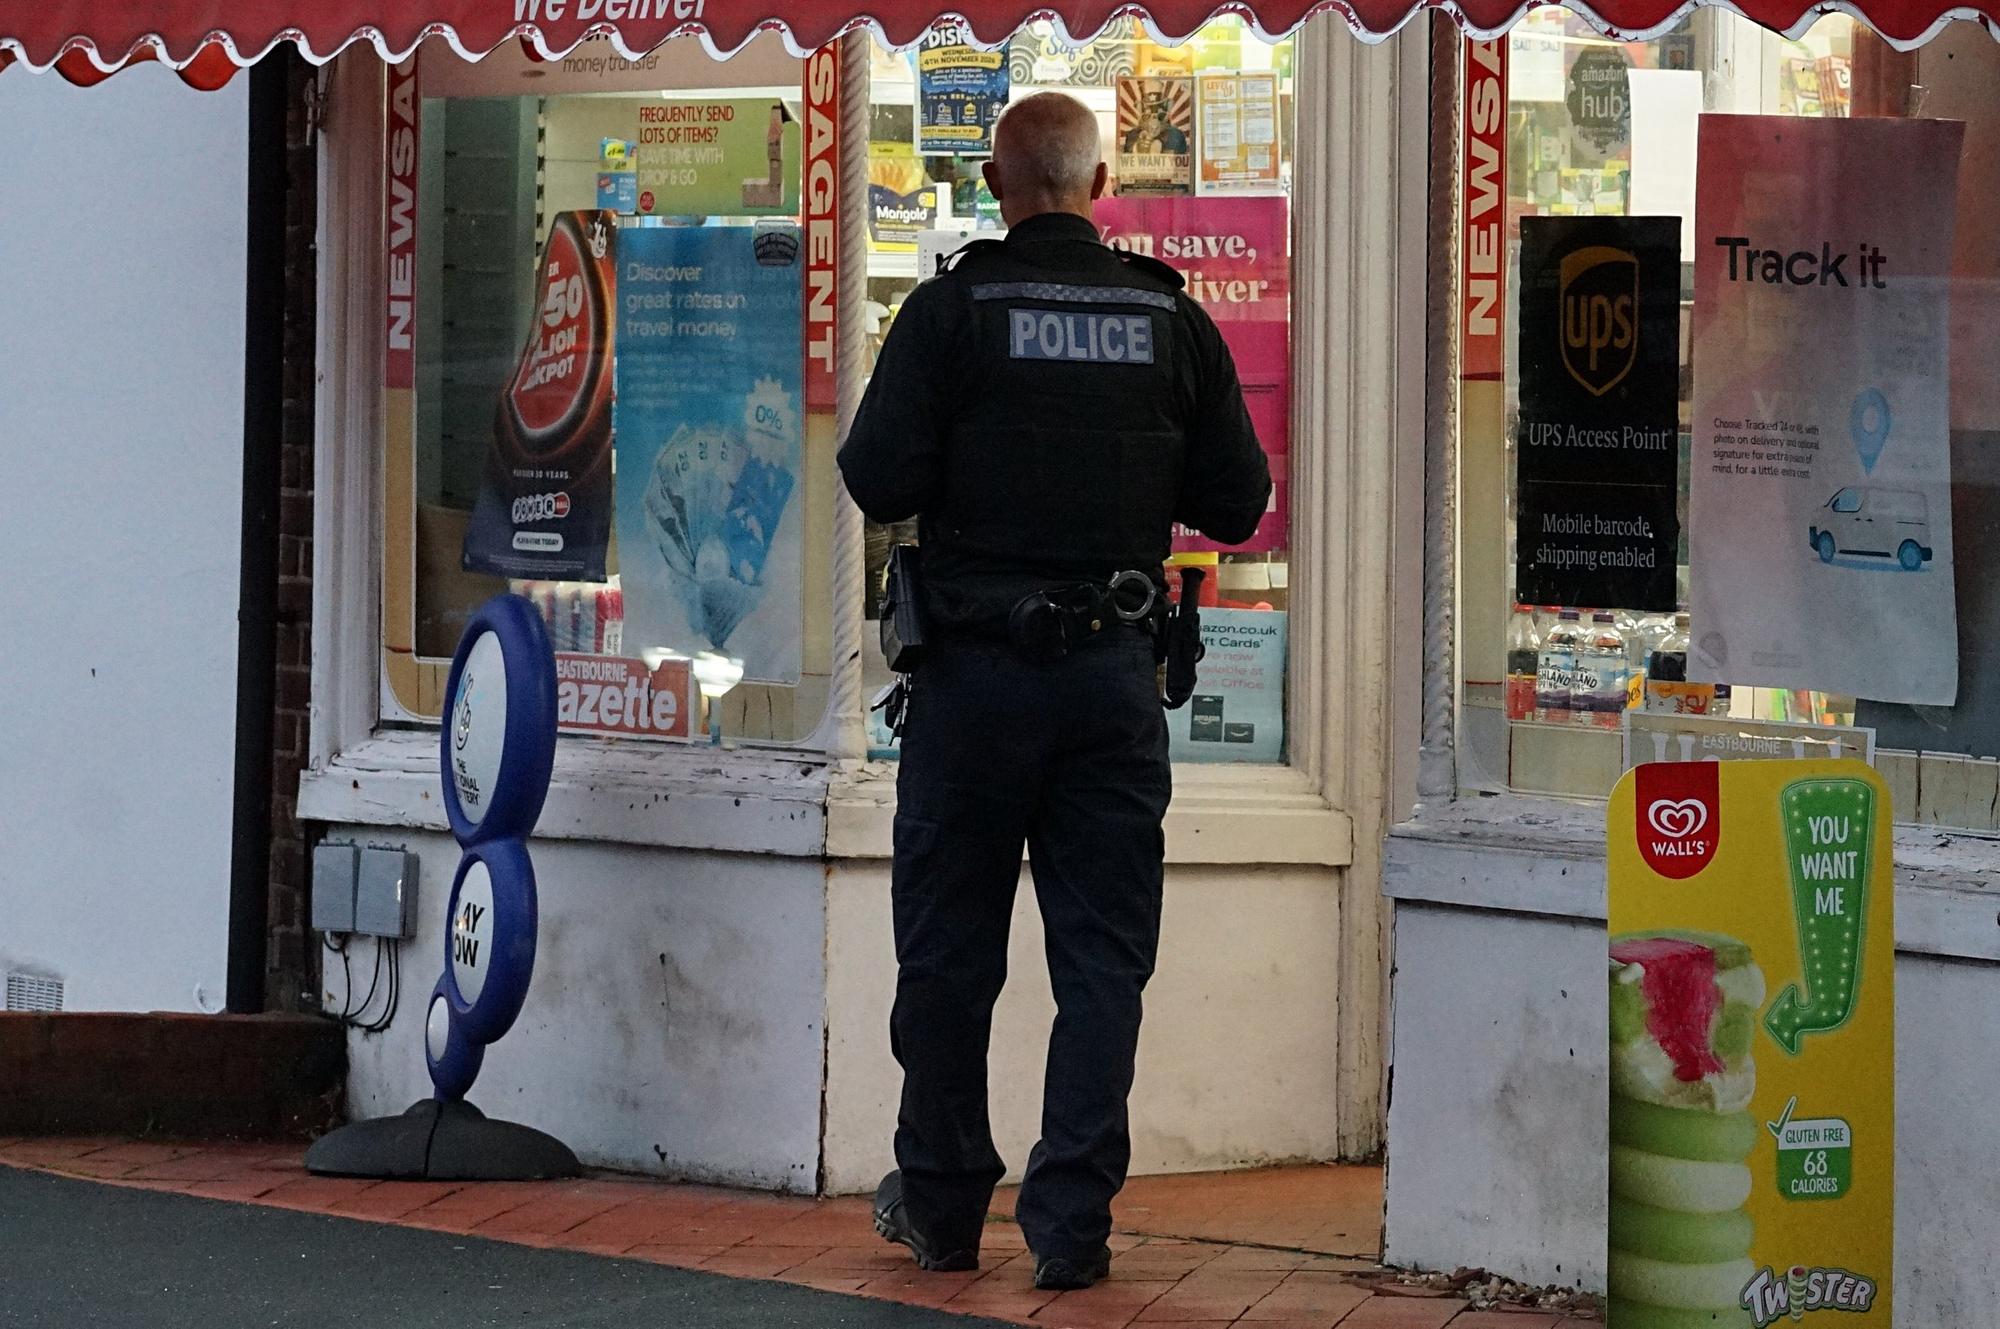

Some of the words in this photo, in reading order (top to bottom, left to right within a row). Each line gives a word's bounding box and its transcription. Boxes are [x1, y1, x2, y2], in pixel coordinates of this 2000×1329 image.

[514, 0, 566, 21] We
[577, 0, 706, 20] Deliver
[562, 58, 606, 77] money
[609, 54, 660, 73] transfer
[941, 55, 979, 64] NOVEMBER
[1581, 66, 1625, 82] amazon
[640, 106, 703, 123] FREQUENTLY
[707, 105, 734, 122] SEND
[1581, 87, 1623, 121] hub
[640, 128, 665, 144] LOTS
[667, 128, 681, 143] OF
[683, 127, 719, 143] ITEMS?
[640, 148, 666, 165] SAVE
[669, 148, 694, 164] TIME
[696, 148, 724, 164] WITH
[1120, 156, 1135, 167] WE
[1138, 156, 1166, 167] WANT
[640, 169, 666, 186] DROP
[679, 169, 697, 185] GO
[809, 46, 834, 373] SAGENT
[876, 205, 928, 224] Marigold
[1162, 234, 1257, 264] save,
[626, 263, 703, 282] Discover
[1715, 236, 1848, 288] Track
[1859, 244, 1887, 289] it
[1181, 269, 1269, 304] liver
[626, 291, 673, 313] great
[677, 292, 722, 310] rates
[725, 293, 747, 309] on
[626, 317, 673, 337] travel
[678, 321, 737, 341] money
[1014, 312, 1150, 361] POLICE
[1566, 292, 1633, 372] ups
[755, 404, 784, 431] 0%
[1713, 418, 1742, 429] Choose
[1745, 419, 1778, 431] Tracked
[1529, 422, 1562, 446] UPS
[1565, 424, 1619, 448] Access
[1623, 425, 1669, 450] Point
[1713, 434, 1736, 444] photo
[1738, 436, 1748, 444] on
[1750, 435, 1784, 447] delivery
[1713, 448, 1750, 460] signature
[1752, 449, 1764, 460] for
[1766, 451, 1788, 462] extra
[1736, 463, 1748, 475] for
[1751, 466, 1757, 475] a
[1759, 465, 1779, 476] little
[1542, 513, 1592, 534] Mobile
[1594, 514, 1650, 537] barcode
[1536, 543, 1597, 571] shipping
[1599, 546, 1656, 568] enabled
[1200, 624, 1278, 636] azon.co.uk
[1201, 636, 1214, 646] ift
[556, 660, 627, 683] EASTBOURNE
[1221, 678, 1265, 690] Office
[557, 675, 677, 731] azette
[1702, 735, 1781, 754] EASTBOURNE
[1808, 816, 1849, 844] YOU
[1652, 841, 1705, 857] WALL'S
[1801, 851, 1858, 880] WANT
[1815, 887, 1845, 916] ME
[454, 932, 479, 968] OW
[1785, 1128, 1820, 1144] GLUTEN
[1823, 1127, 1844, 1142] FREE
[1803, 1150, 1828, 1175] 68
[1791, 1177, 1838, 1194] CALORIES
